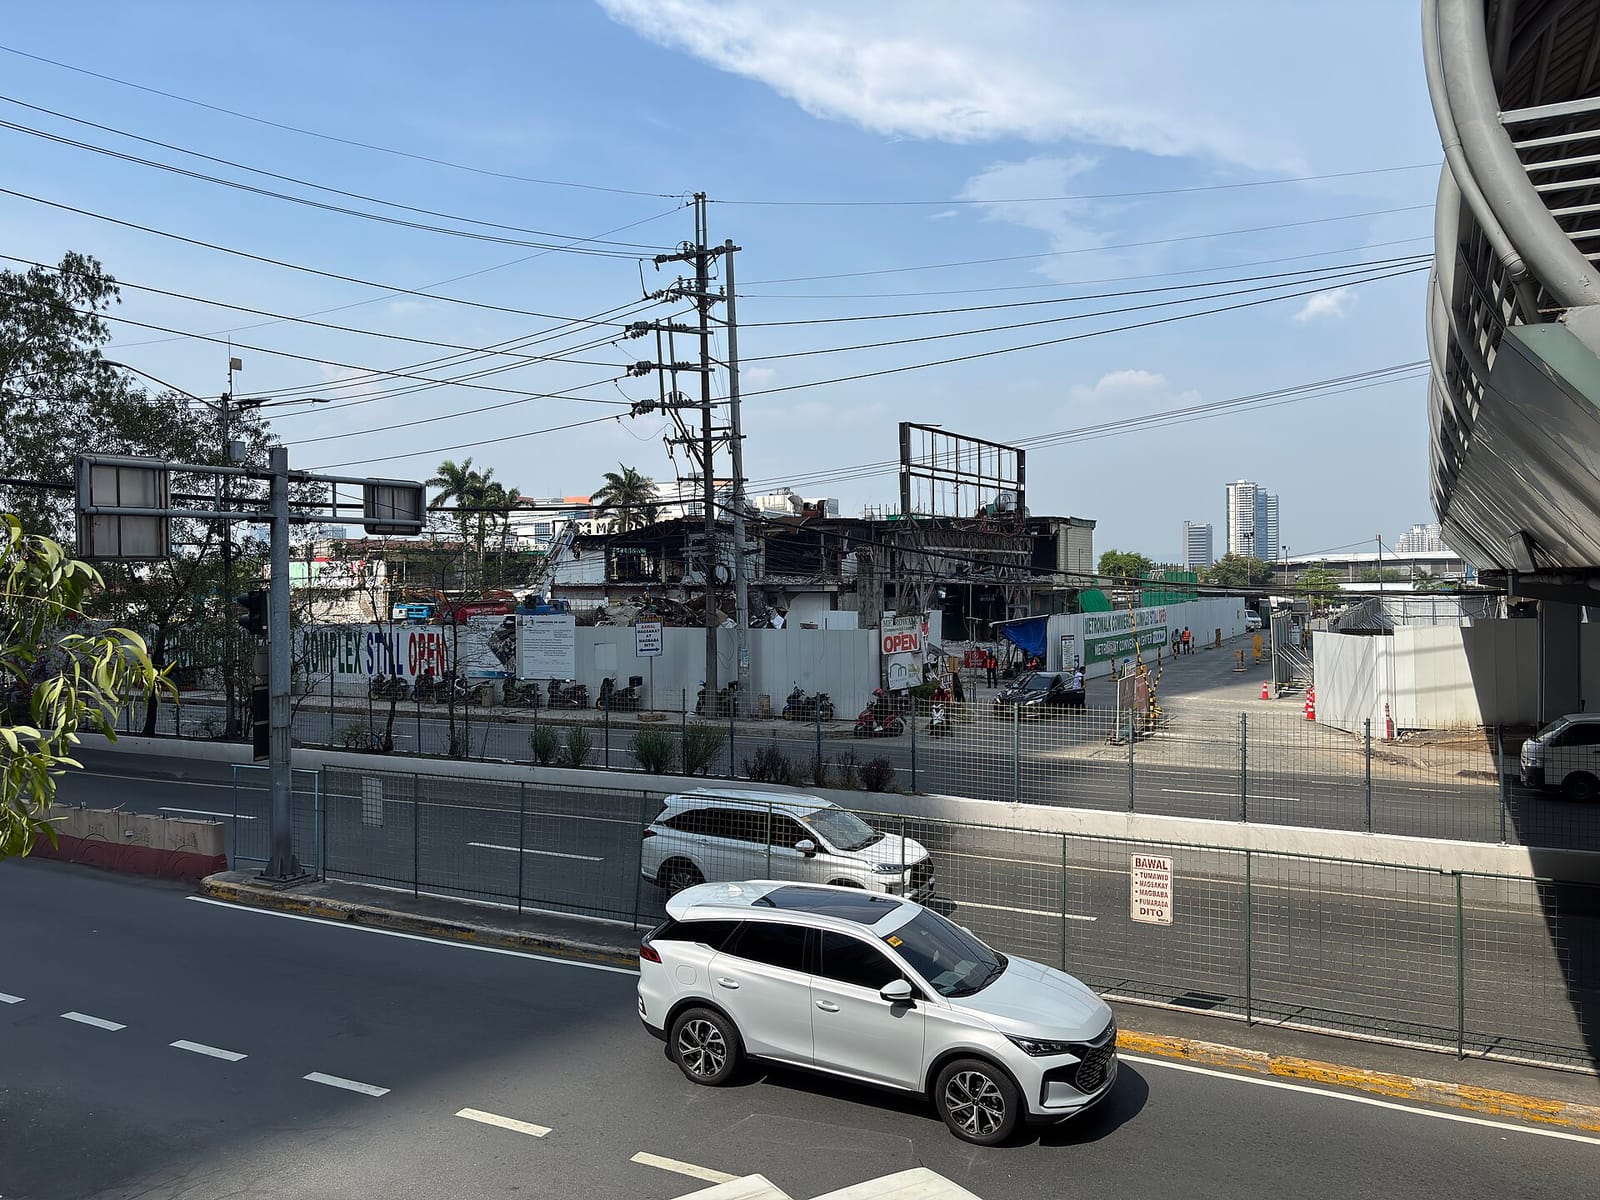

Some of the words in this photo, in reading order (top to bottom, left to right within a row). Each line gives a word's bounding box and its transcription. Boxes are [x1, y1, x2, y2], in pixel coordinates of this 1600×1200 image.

[883, 634, 918, 653] OPEN
[303, 632, 362, 674] COMPLEX
[367, 632, 403, 675] STILL
[408, 632, 446, 676] OPEN
[1135, 858, 1168, 870] BAWAL
[1140, 872, 1169, 880] TUMAWID
[1139, 880, 1169, 889] MAGSAKAY
[1139, 889, 1168, 898] MAGBABA
[1139, 898, 1169, 907] PUMARADA
[1140, 908, 1163, 917] DITO
